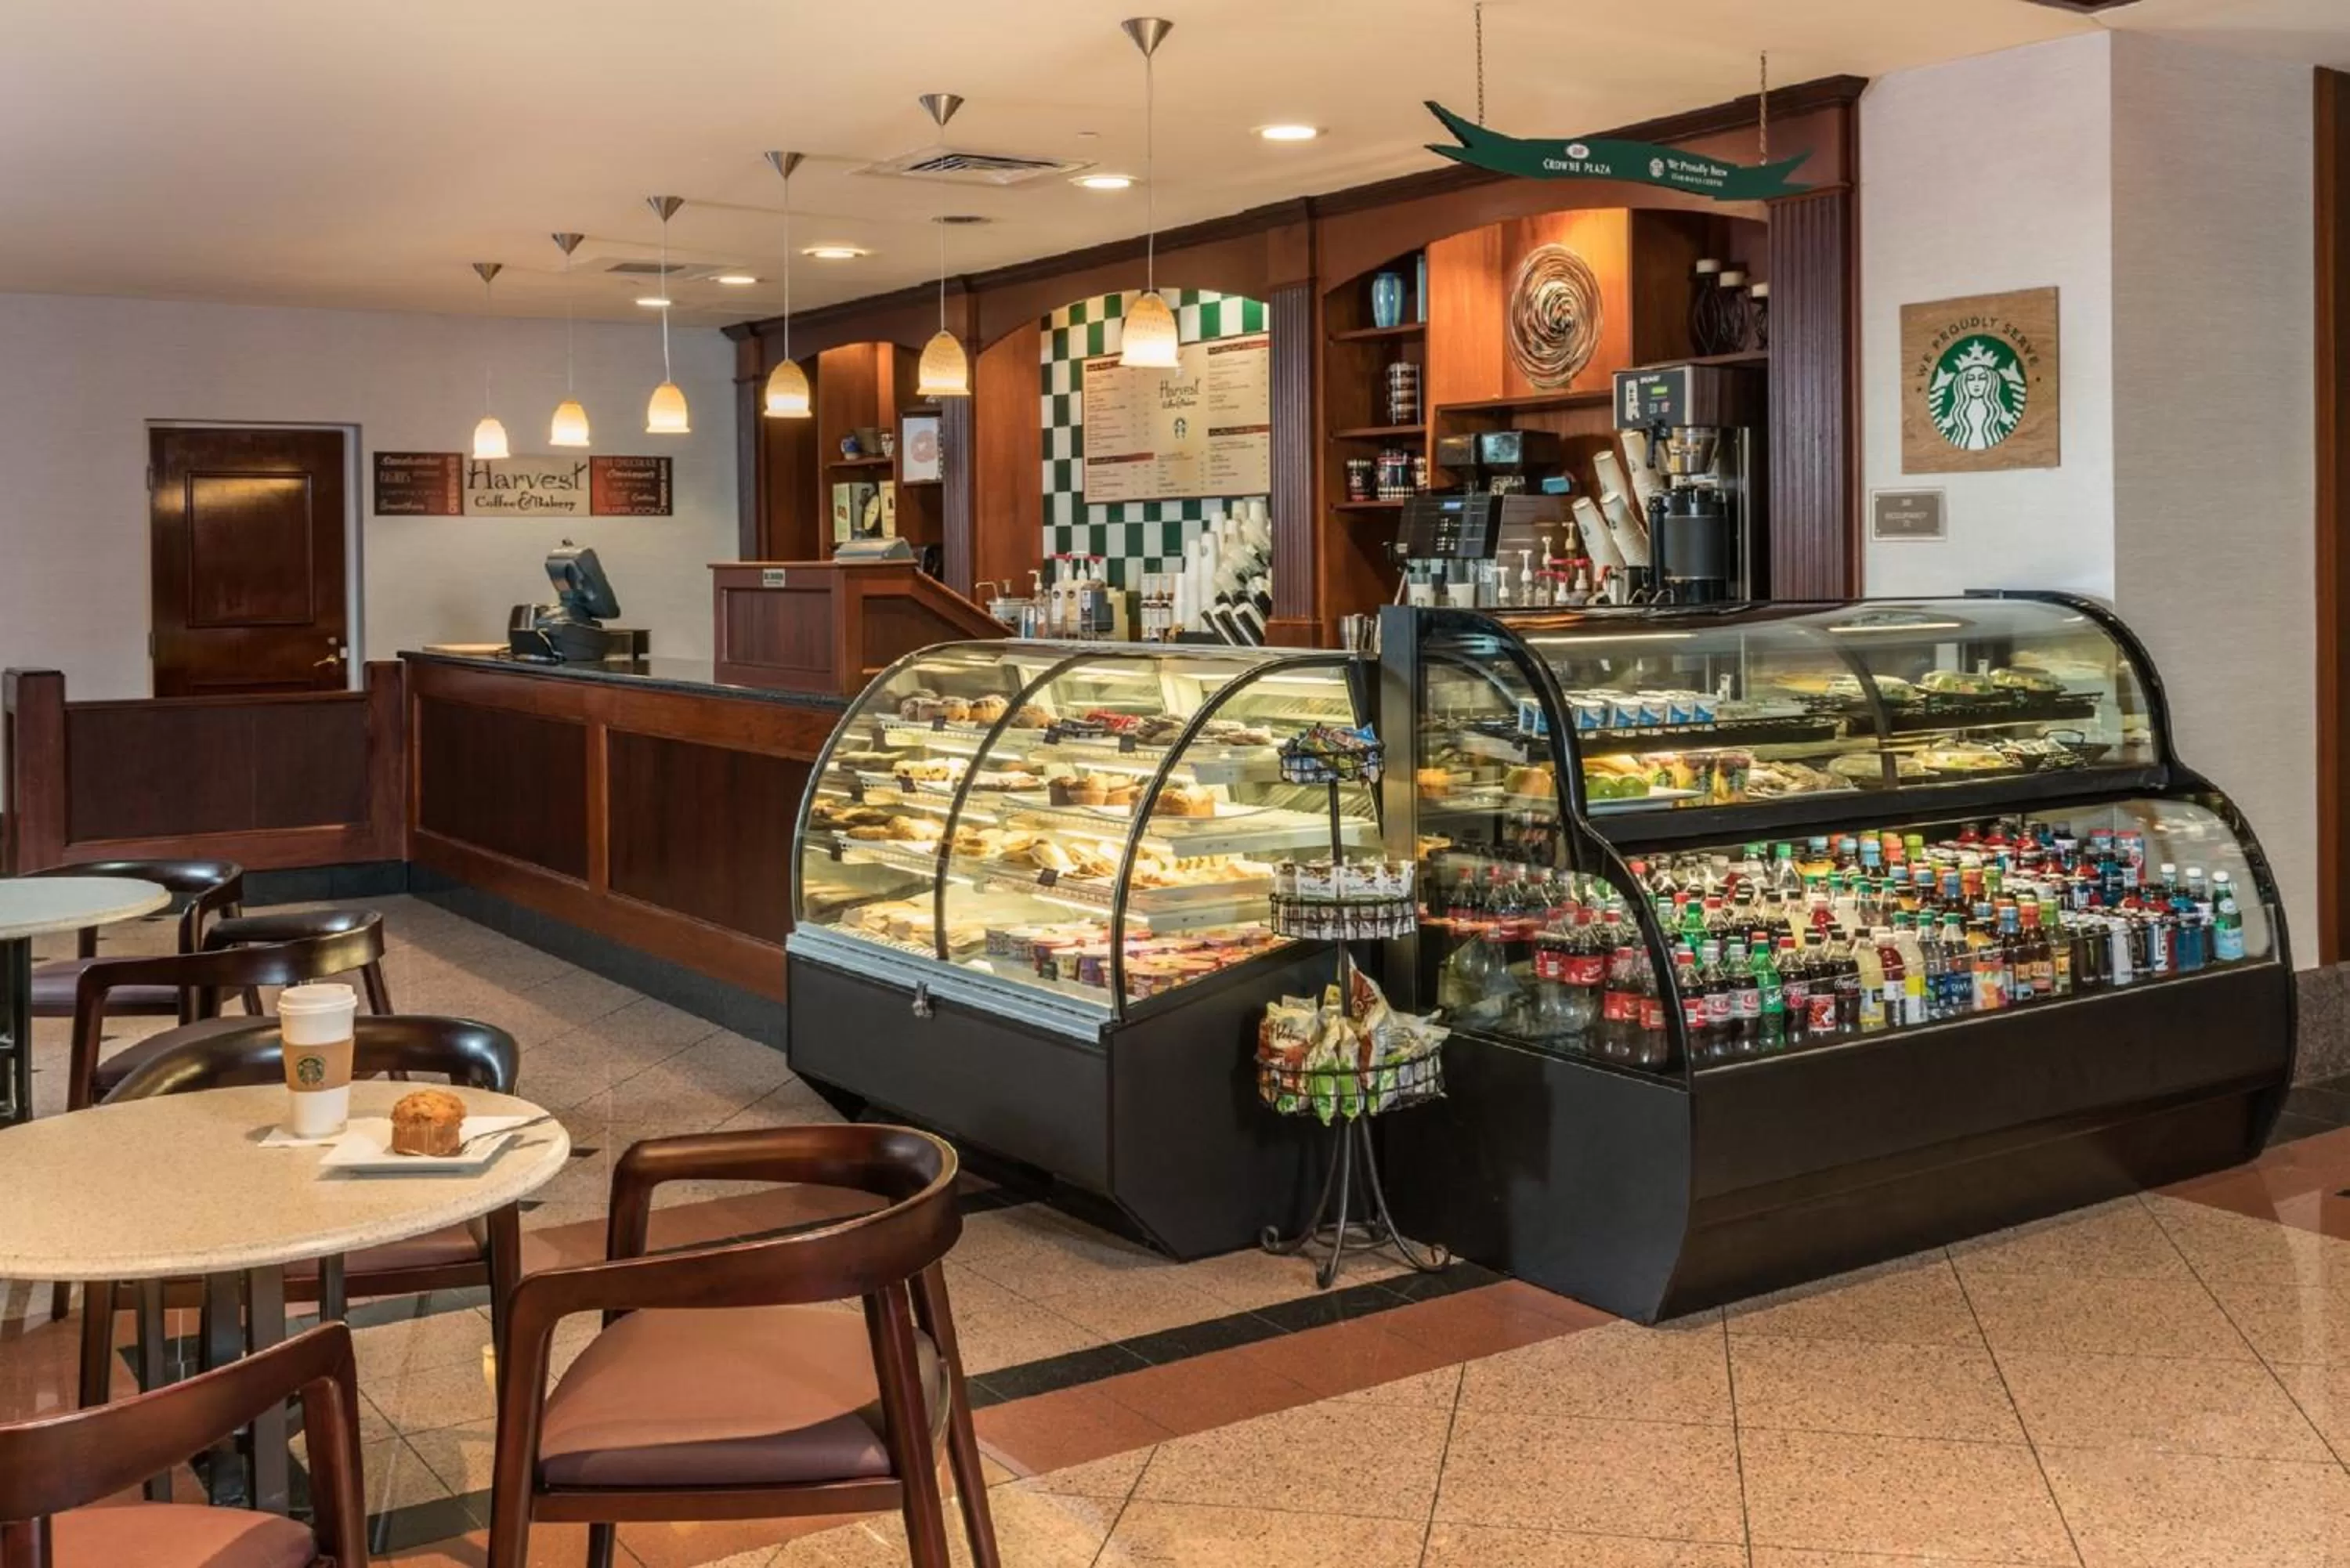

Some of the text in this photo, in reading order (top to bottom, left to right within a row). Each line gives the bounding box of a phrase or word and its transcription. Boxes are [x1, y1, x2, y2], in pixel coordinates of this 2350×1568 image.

[1542, 157, 1611, 175] CROWNE PLAZA
[1680, 161, 1708, 177] Proudly
[1916, 316, 2041, 377] WE PROUDLY SERVE
[467, 460, 588, 490] Harvest
[475, 493, 517, 508] Coffee
[530, 493, 577, 511] Bakery
